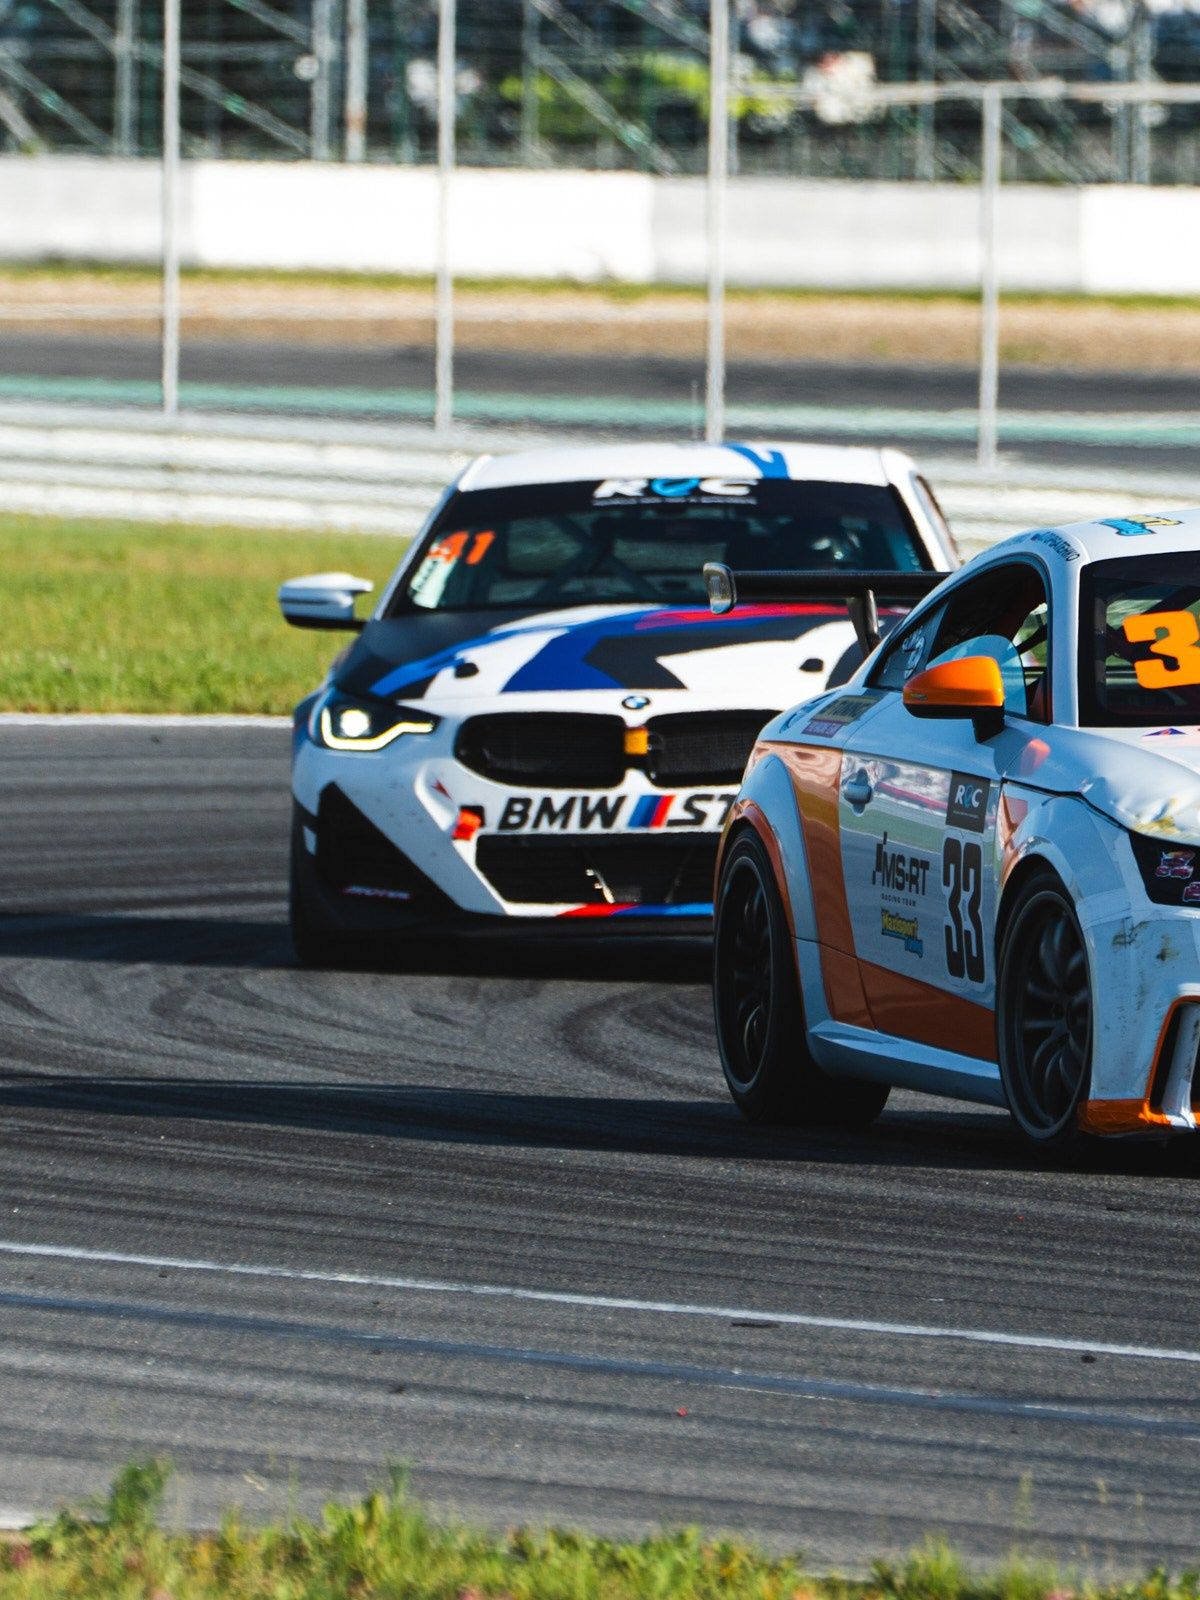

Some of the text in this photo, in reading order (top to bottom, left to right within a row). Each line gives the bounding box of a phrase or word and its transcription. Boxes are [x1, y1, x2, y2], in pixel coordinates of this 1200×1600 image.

[428, 530, 495, 565] 41
[498, 795, 628, 830] BMW
[943, 837, 985, 983] 33
